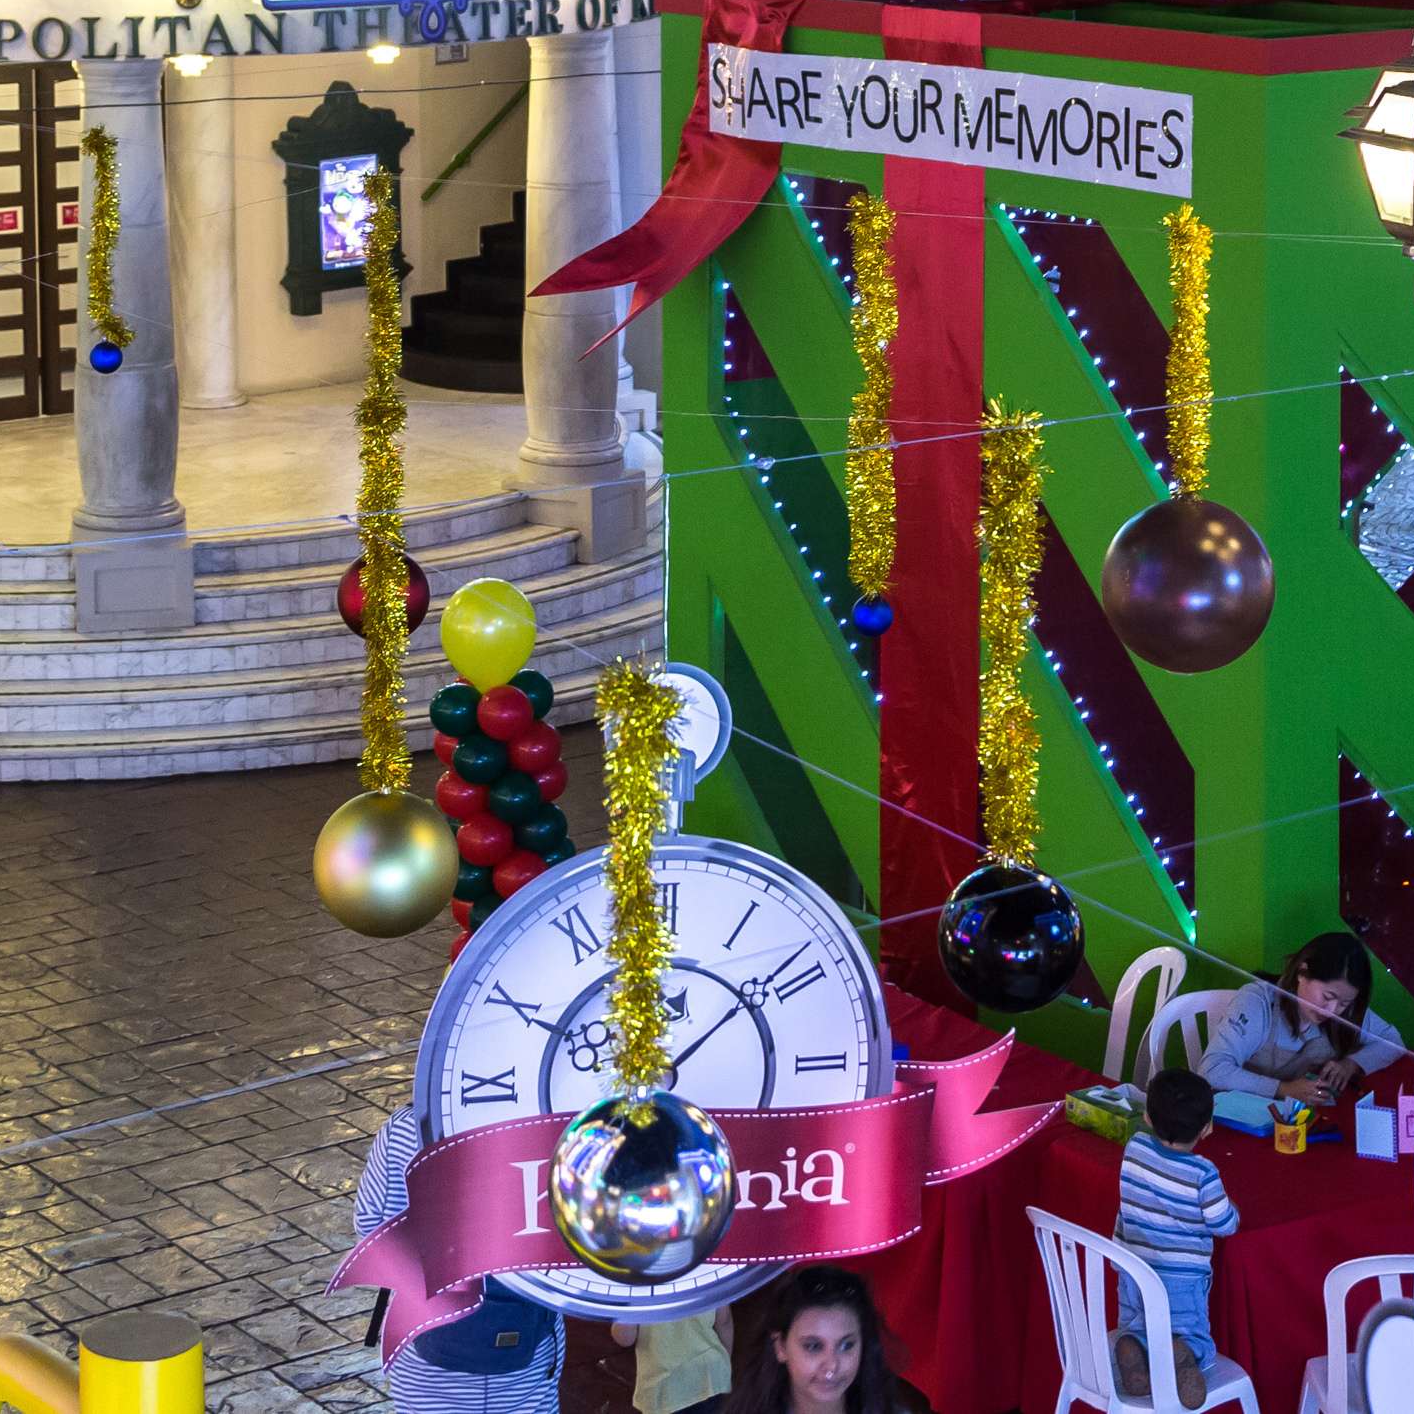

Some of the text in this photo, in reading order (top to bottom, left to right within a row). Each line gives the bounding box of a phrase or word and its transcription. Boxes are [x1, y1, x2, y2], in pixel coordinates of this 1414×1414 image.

[711, 57, 1184, 180] SHARE YOUR MEMORIES
